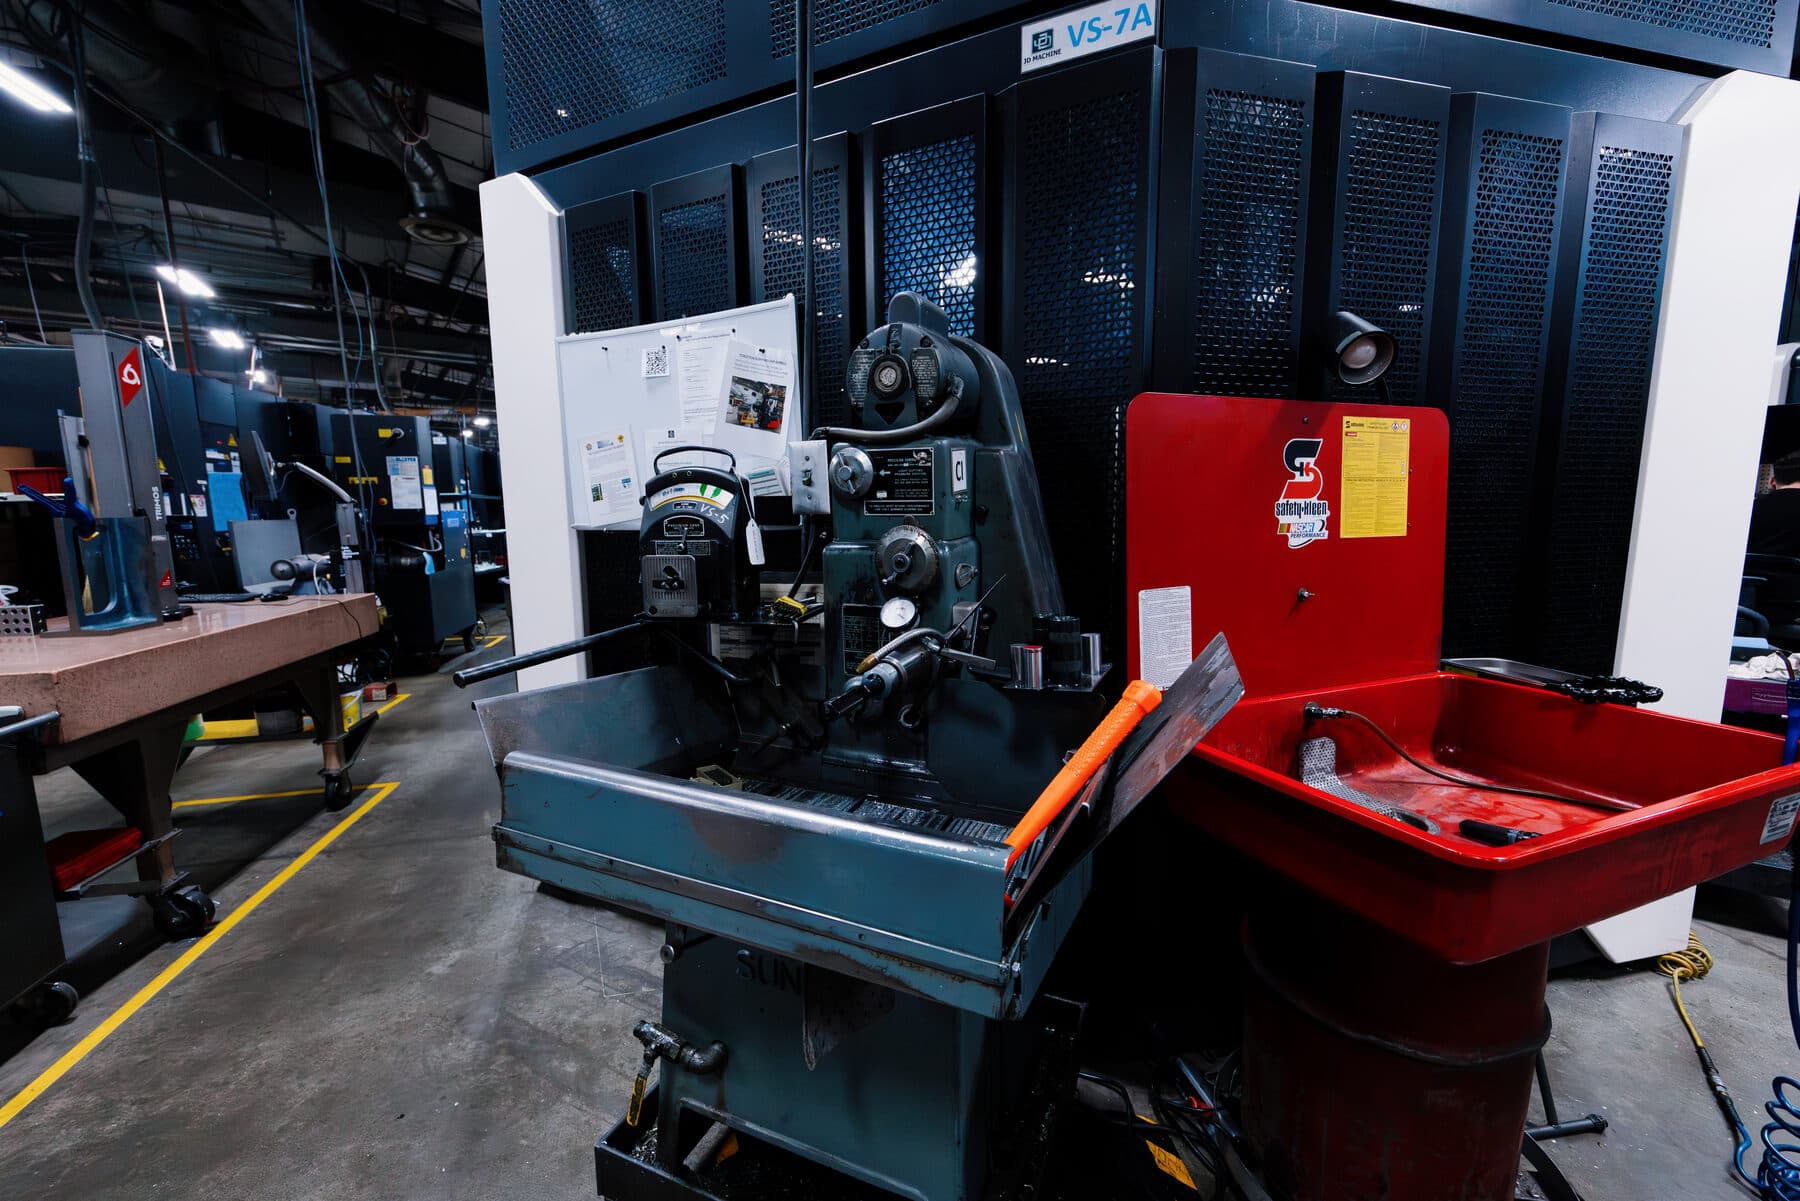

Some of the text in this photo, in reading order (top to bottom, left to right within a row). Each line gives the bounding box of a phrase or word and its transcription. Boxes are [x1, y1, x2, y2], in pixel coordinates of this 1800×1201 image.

[1067, 3, 1152, 47] VS-7A
[1033, 48, 1062, 61] MACHINE
[152, 486, 163, 521] TRIMOS
[700, 503, 729, 524] VS-5
